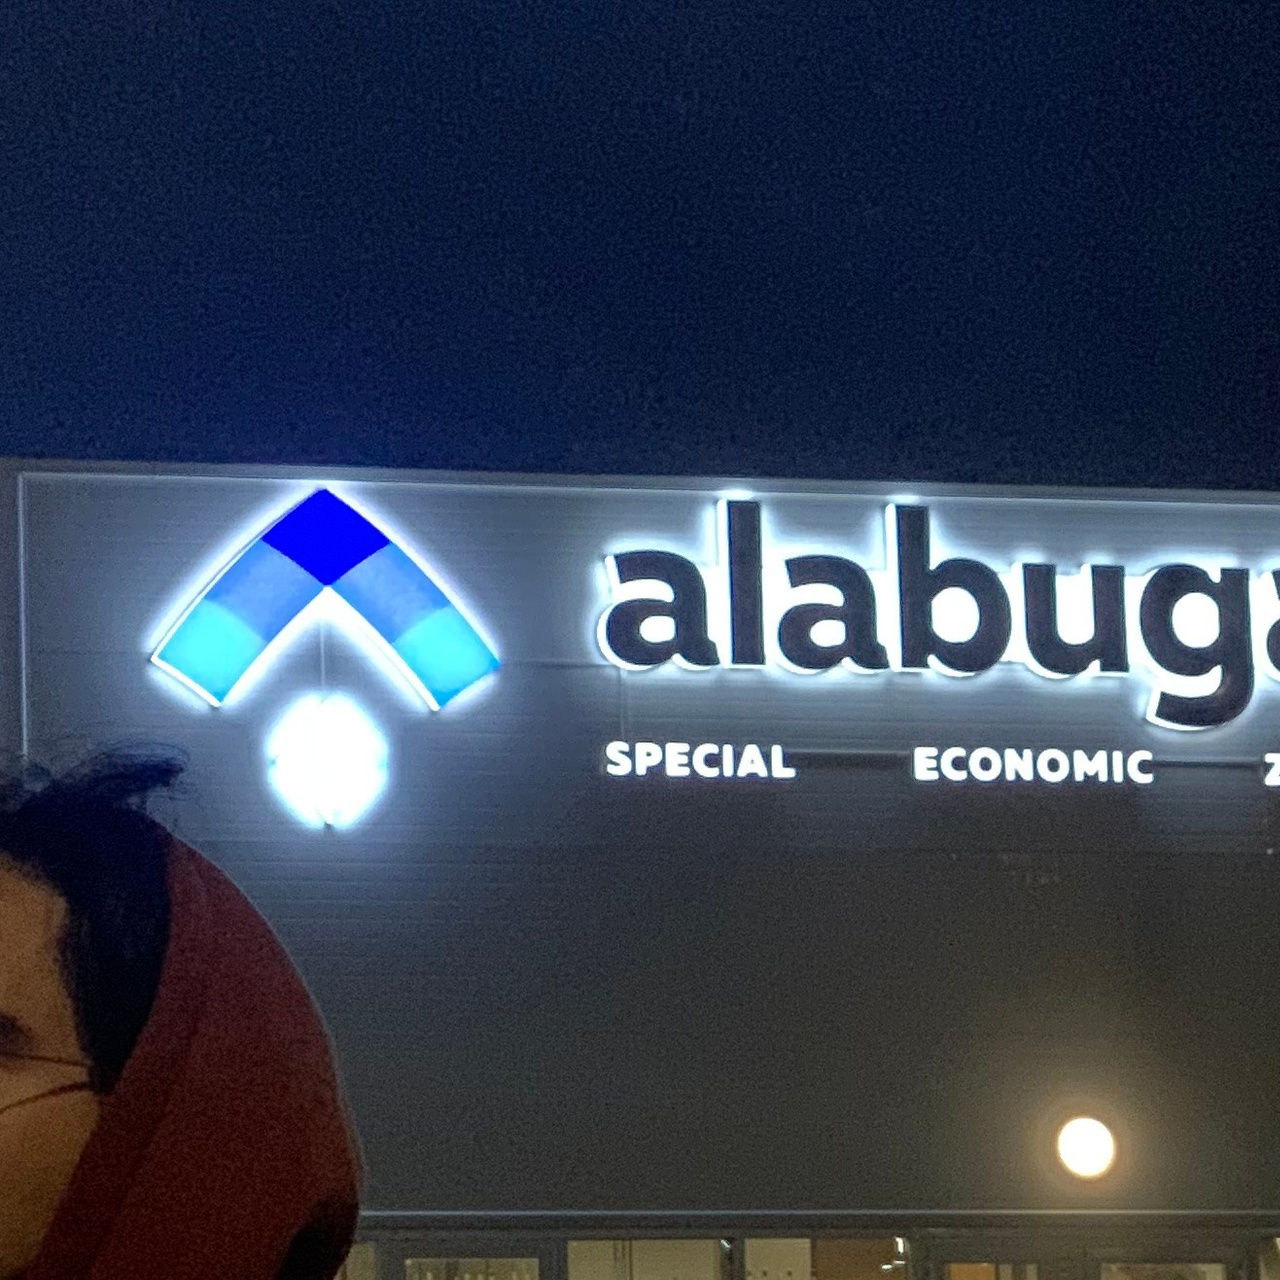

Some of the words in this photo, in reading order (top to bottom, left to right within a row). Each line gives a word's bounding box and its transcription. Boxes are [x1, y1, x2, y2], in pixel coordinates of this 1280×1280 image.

[604, 499, 1280, 728] alabug
[605, 741, 797, 781] SPECIAL
[913, 747, 1154, 785] ECONOMIC
